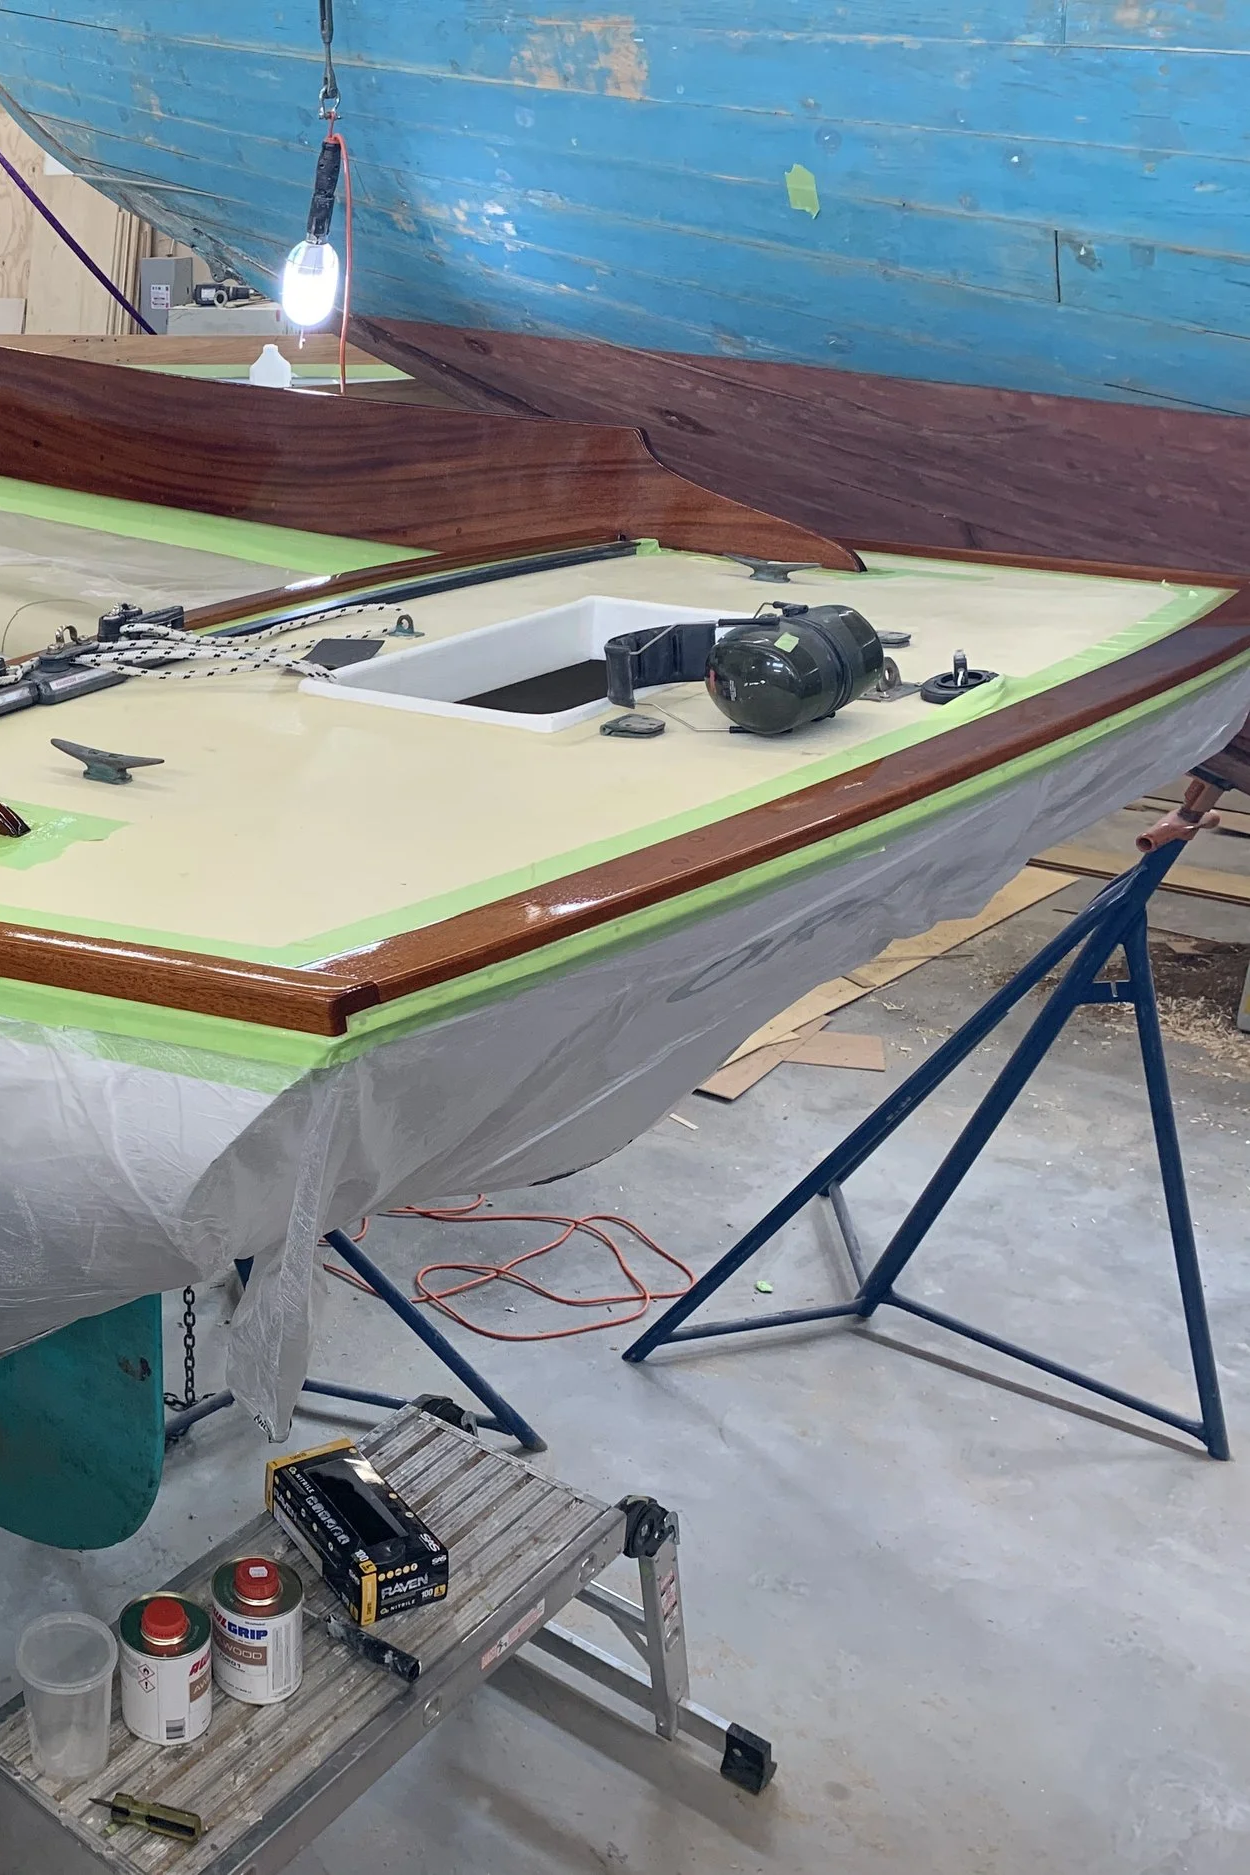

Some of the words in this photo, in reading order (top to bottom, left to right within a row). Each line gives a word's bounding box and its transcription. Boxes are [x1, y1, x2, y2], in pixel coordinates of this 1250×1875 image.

[295, 1472, 315, 1494] NITRILE
[419, 1532, 441, 1552] SAS
[354, 1549, 370, 1562] 100
[431, 1554, 447, 1566] SAS
[381, 1572, 429, 1600] RAVEN
[421, 1588, 434, 1599] 100
[390, 1599, 416, 1611] NITRILE
